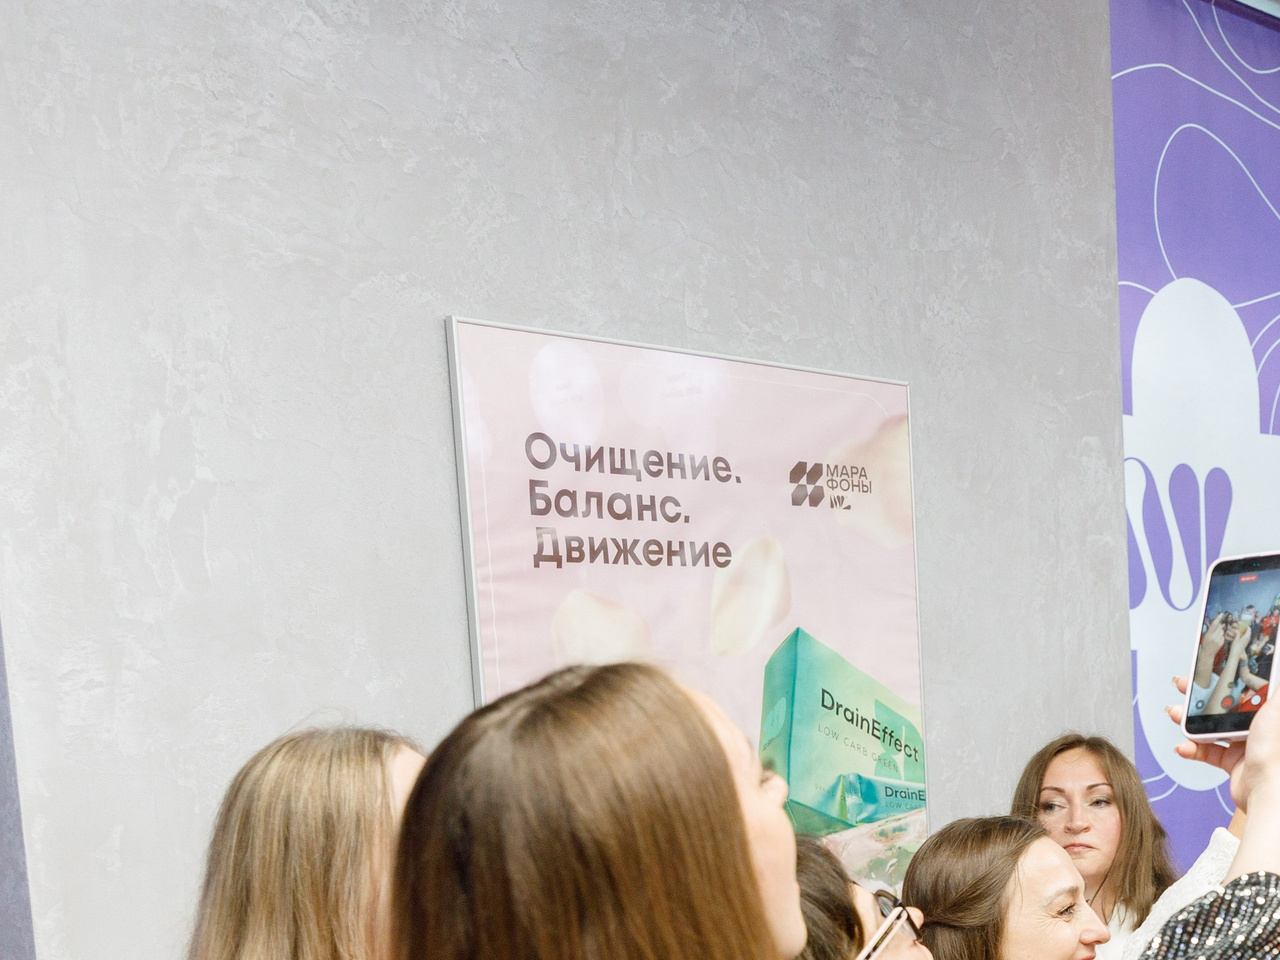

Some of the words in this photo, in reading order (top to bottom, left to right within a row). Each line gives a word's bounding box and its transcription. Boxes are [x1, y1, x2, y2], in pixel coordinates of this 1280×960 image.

[525, 432, 742, 483] Очищение.
[826, 464, 868, 480] МАРА
[529, 479, 690, 524] Баланс.
[826, 478, 872, 494] ФОНЫ
[533, 527, 732, 569] Движение
[821, 688, 919, 763] DrainEffect
[818, 724, 840, 741] LOW
[844, 736, 869, 757] CARB
[871, 751, 899, 773] GREEN
[885, 786, 926, 802] DrainE
